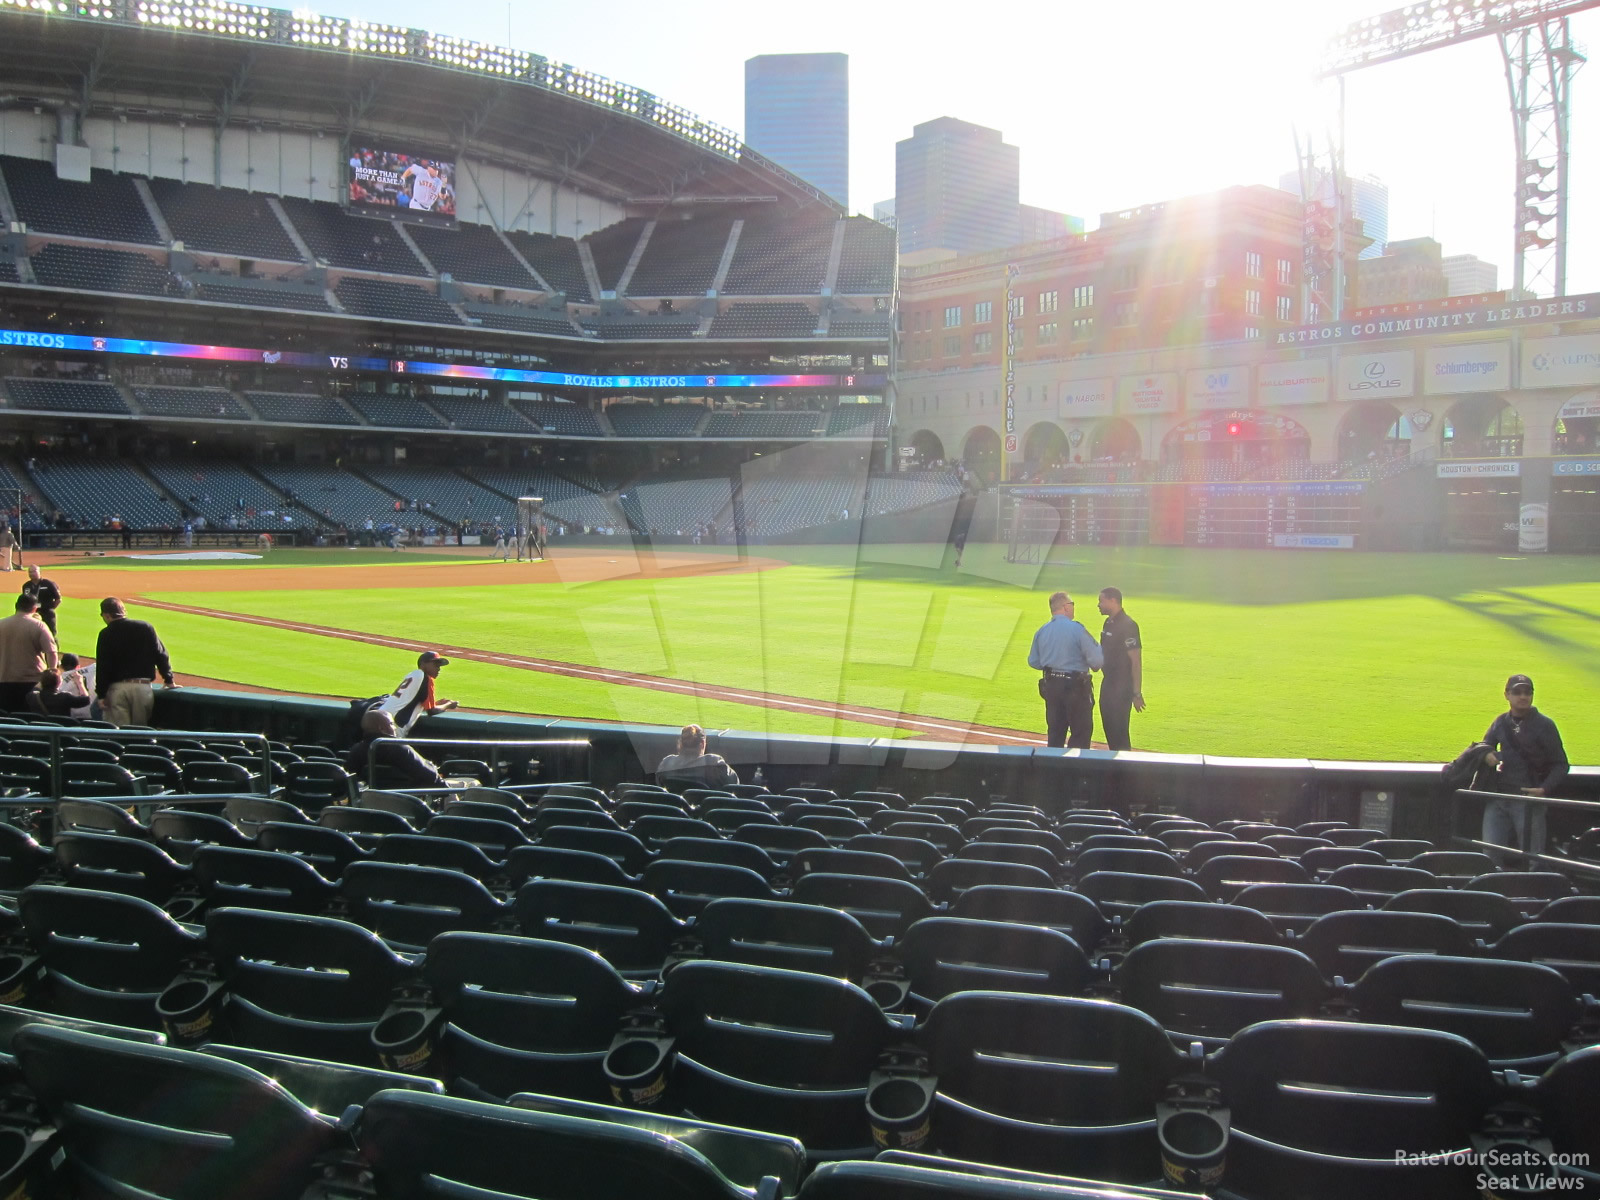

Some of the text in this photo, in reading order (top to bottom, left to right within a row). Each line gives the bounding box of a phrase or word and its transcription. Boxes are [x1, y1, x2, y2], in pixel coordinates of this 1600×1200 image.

[355, 167, 397, 178] MORE THAN
[355, 173, 369, 181] JUST
[1441, 296, 1489, 308] MAID
[1007, 289, 1015, 356] CHIKIN
[1276, 299, 1588, 345] ASTROS COMMUNITY LEADERS
[0, 331, 65, 349] STROS
[329, 356, 349, 369] VS
[1434, 361, 1499, 377] Schlumberger
[564, 374, 614, 388] ROYALS
[634, 376, 686, 387] ASTROS
[1259, 377, 1326, 388] HALLIBURTON
[1348, 379, 1401, 392] LEXUS
[1074, 393, 1106, 404] NABORS
[1440, 463, 1516, 474] HOUSTON CHRONICLE
[1558, 463, 1567, 473] C
[1575, 463, 1584, 472] D
[1302, 536, 1339, 546] mazda
